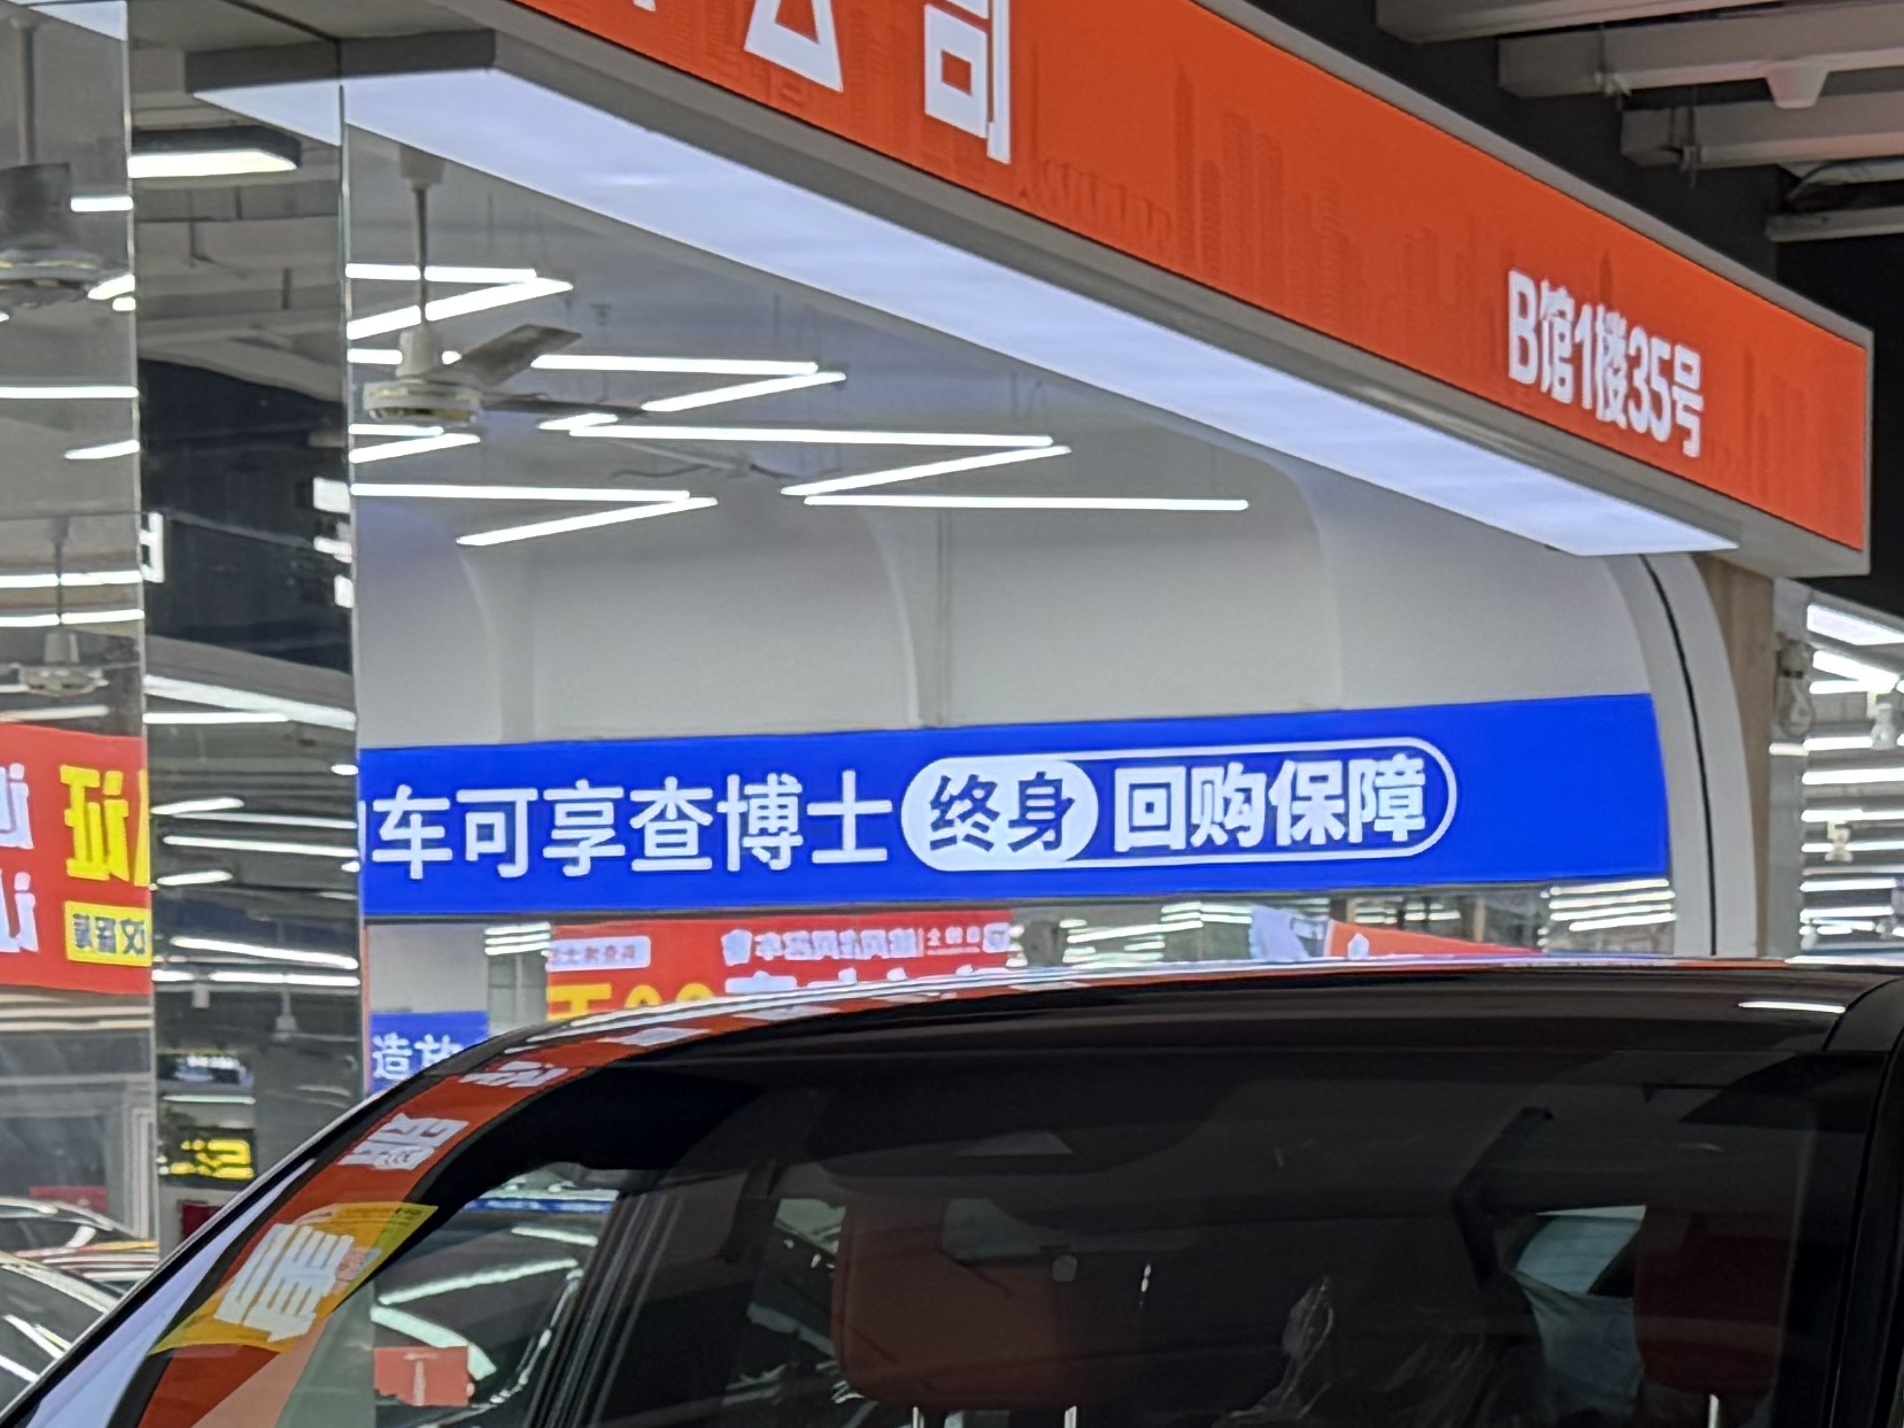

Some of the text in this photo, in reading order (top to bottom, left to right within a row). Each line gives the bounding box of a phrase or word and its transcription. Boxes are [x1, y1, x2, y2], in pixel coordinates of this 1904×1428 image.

[1508, 269, 1704, 457] B馆1楼35号
[359, 753, 1427, 880] 车可享查博士 终身 回购保障
